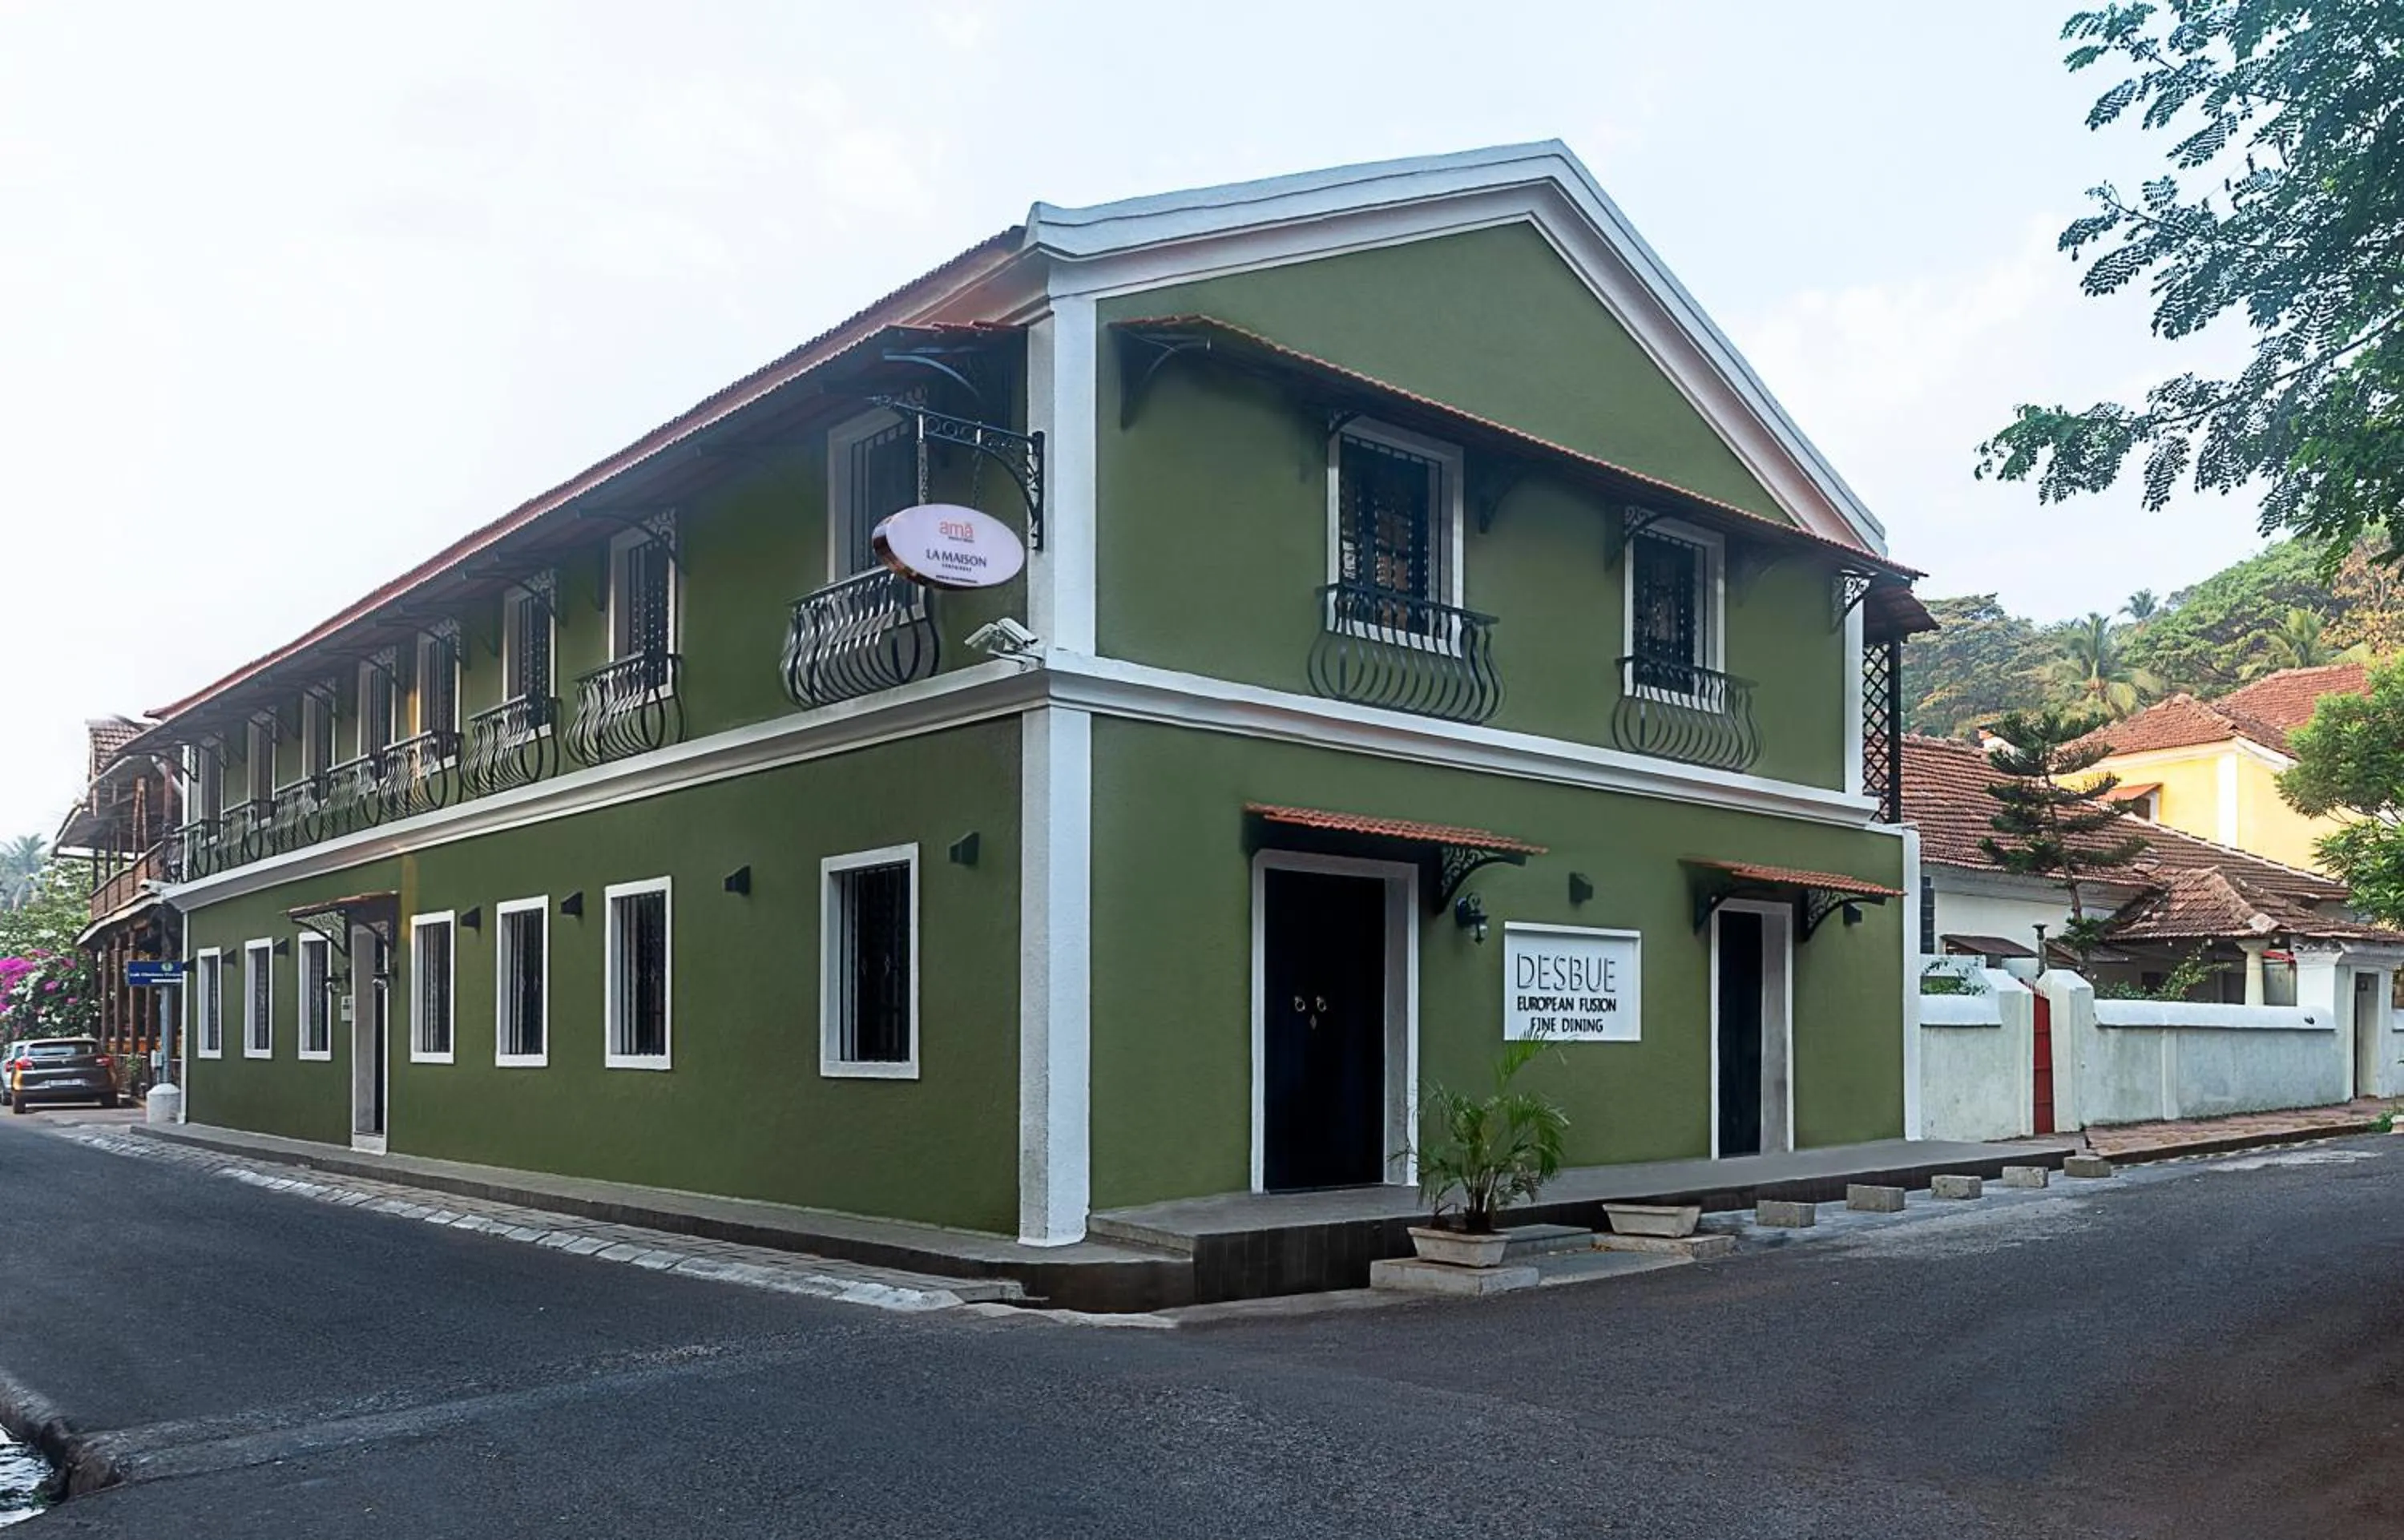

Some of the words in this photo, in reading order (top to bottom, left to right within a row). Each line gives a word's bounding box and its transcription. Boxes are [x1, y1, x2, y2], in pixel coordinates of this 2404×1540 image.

[926, 548, 940, 561] LA
[942, 551, 987, 568] MAISON
[1517, 953, 1615, 993] DESBUE
[1517, 996, 1575, 1012] EUROPEAN
[1579, 998, 1616, 1013] FUSION
[1531, 1017, 1556, 1032] FINE
[1562, 1018, 1603, 1034] DINING
